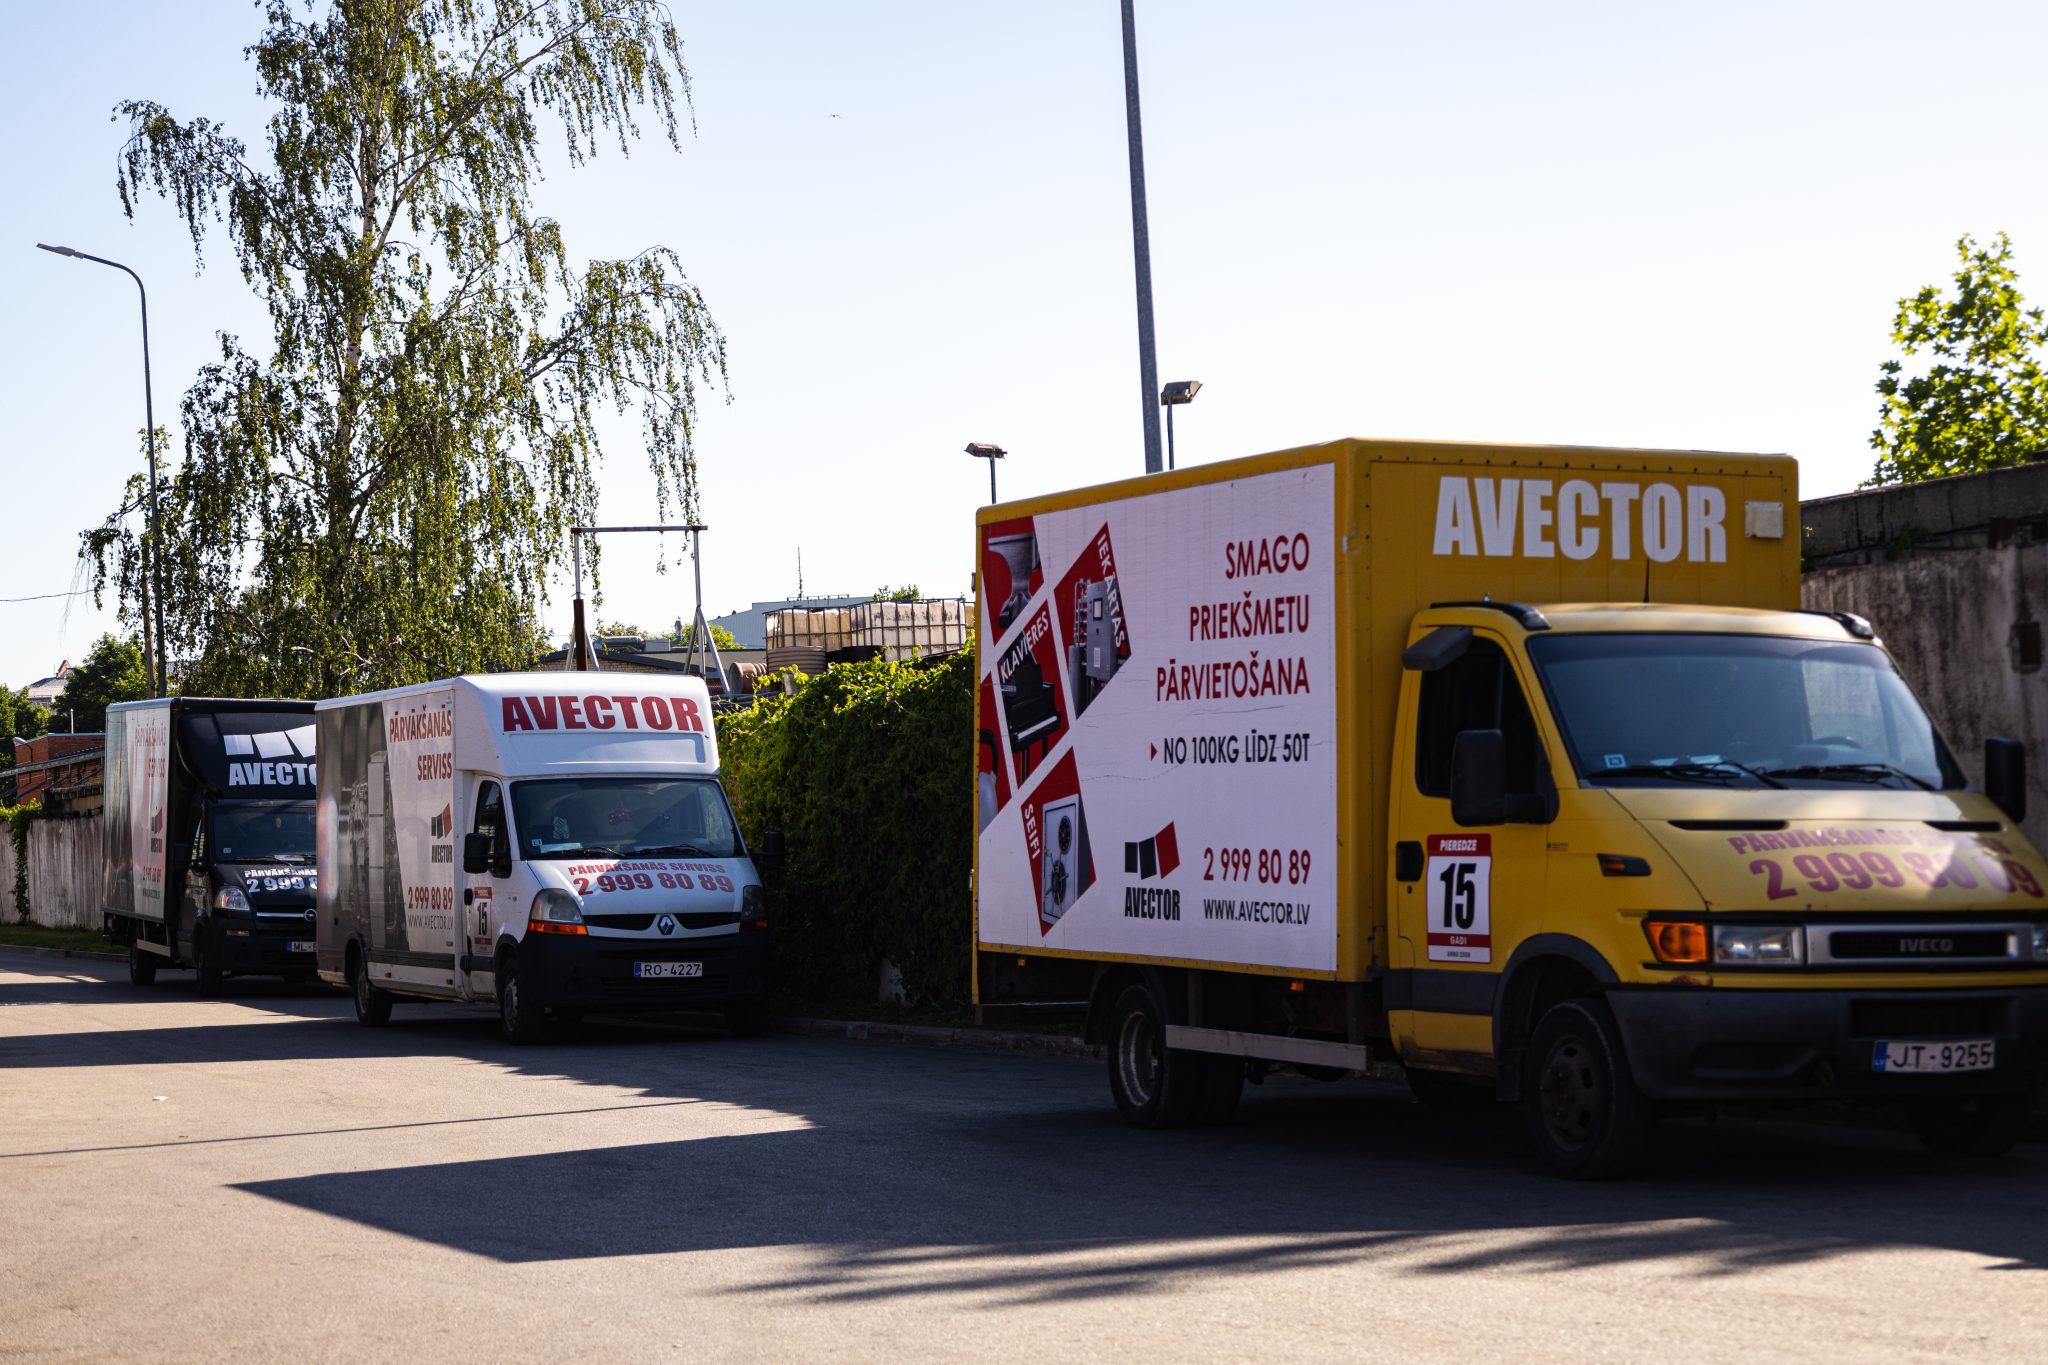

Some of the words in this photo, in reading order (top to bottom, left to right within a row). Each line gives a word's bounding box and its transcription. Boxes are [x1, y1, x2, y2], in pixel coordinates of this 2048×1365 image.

[1432, 476, 1727, 563] AVECTOR
[1225, 532, 1310, 580] SMAGO
[1098, 534, 1126, 648] IEKĀRTAS
[1190, 590, 1310, 642] PRIEKŠMETU
[1000, 610, 1049, 684] KLAVIERES
[1156, 650, 1310, 702] PĀRVIETOŠANA
[390, 704, 452, 742] PĀRVĀKŠANĀS
[502, 695, 704, 732] AVECTOR
[1164, 737, 1187, 764] NO
[1192, 734, 1240, 763] 100KG
[1245, 729, 1278, 763] LĪDZ
[1282, 732, 1310, 762] 50T
[417, 752, 452, 781] SERVISS
[1024, 802, 1041, 860] SEIFI
[1440, 839, 1478, 852] PIEREDZE
[431, 844, 452, 863] AVECTOR
[669, 863, 726, 874] SERVISS
[1204, 848, 1214, 881] 2
[1221, 848, 1252, 882] 999
[1258, 848, 1282, 884] 80
[1288, 850, 1312, 885] 89
[246, 878, 260, 893] 2
[264, 876, 305, 890] 999
[308, 876, 318, 890] 8
[573, 877, 594, 896] 2
[596, 873, 654, 892] 999
[656, 872, 695, 890] 80
[698, 874, 735, 892] 89
[1750, 859, 1798, 900] 2
[1792, 851, 1906, 893] 999
[408, 886, 414, 909] 2
[414, 886, 429, 909] 999
[431, 886, 441, 910] 80
[442, 886, 454, 910] 89
[1124, 886, 1180, 921] AVECTOR
[1204, 898, 1310, 926] WWW.AVECTOR.LV
[1440, 863, 1476, 930] 15
[477, 902, 488, 936] 15
[1450, 936, 1468, 945] GADI
[1900, 938, 1954, 952] IVECO
[644, 964, 700, 976] RO-4227
[1892, 1042, 1992, 1069] JT-9255
